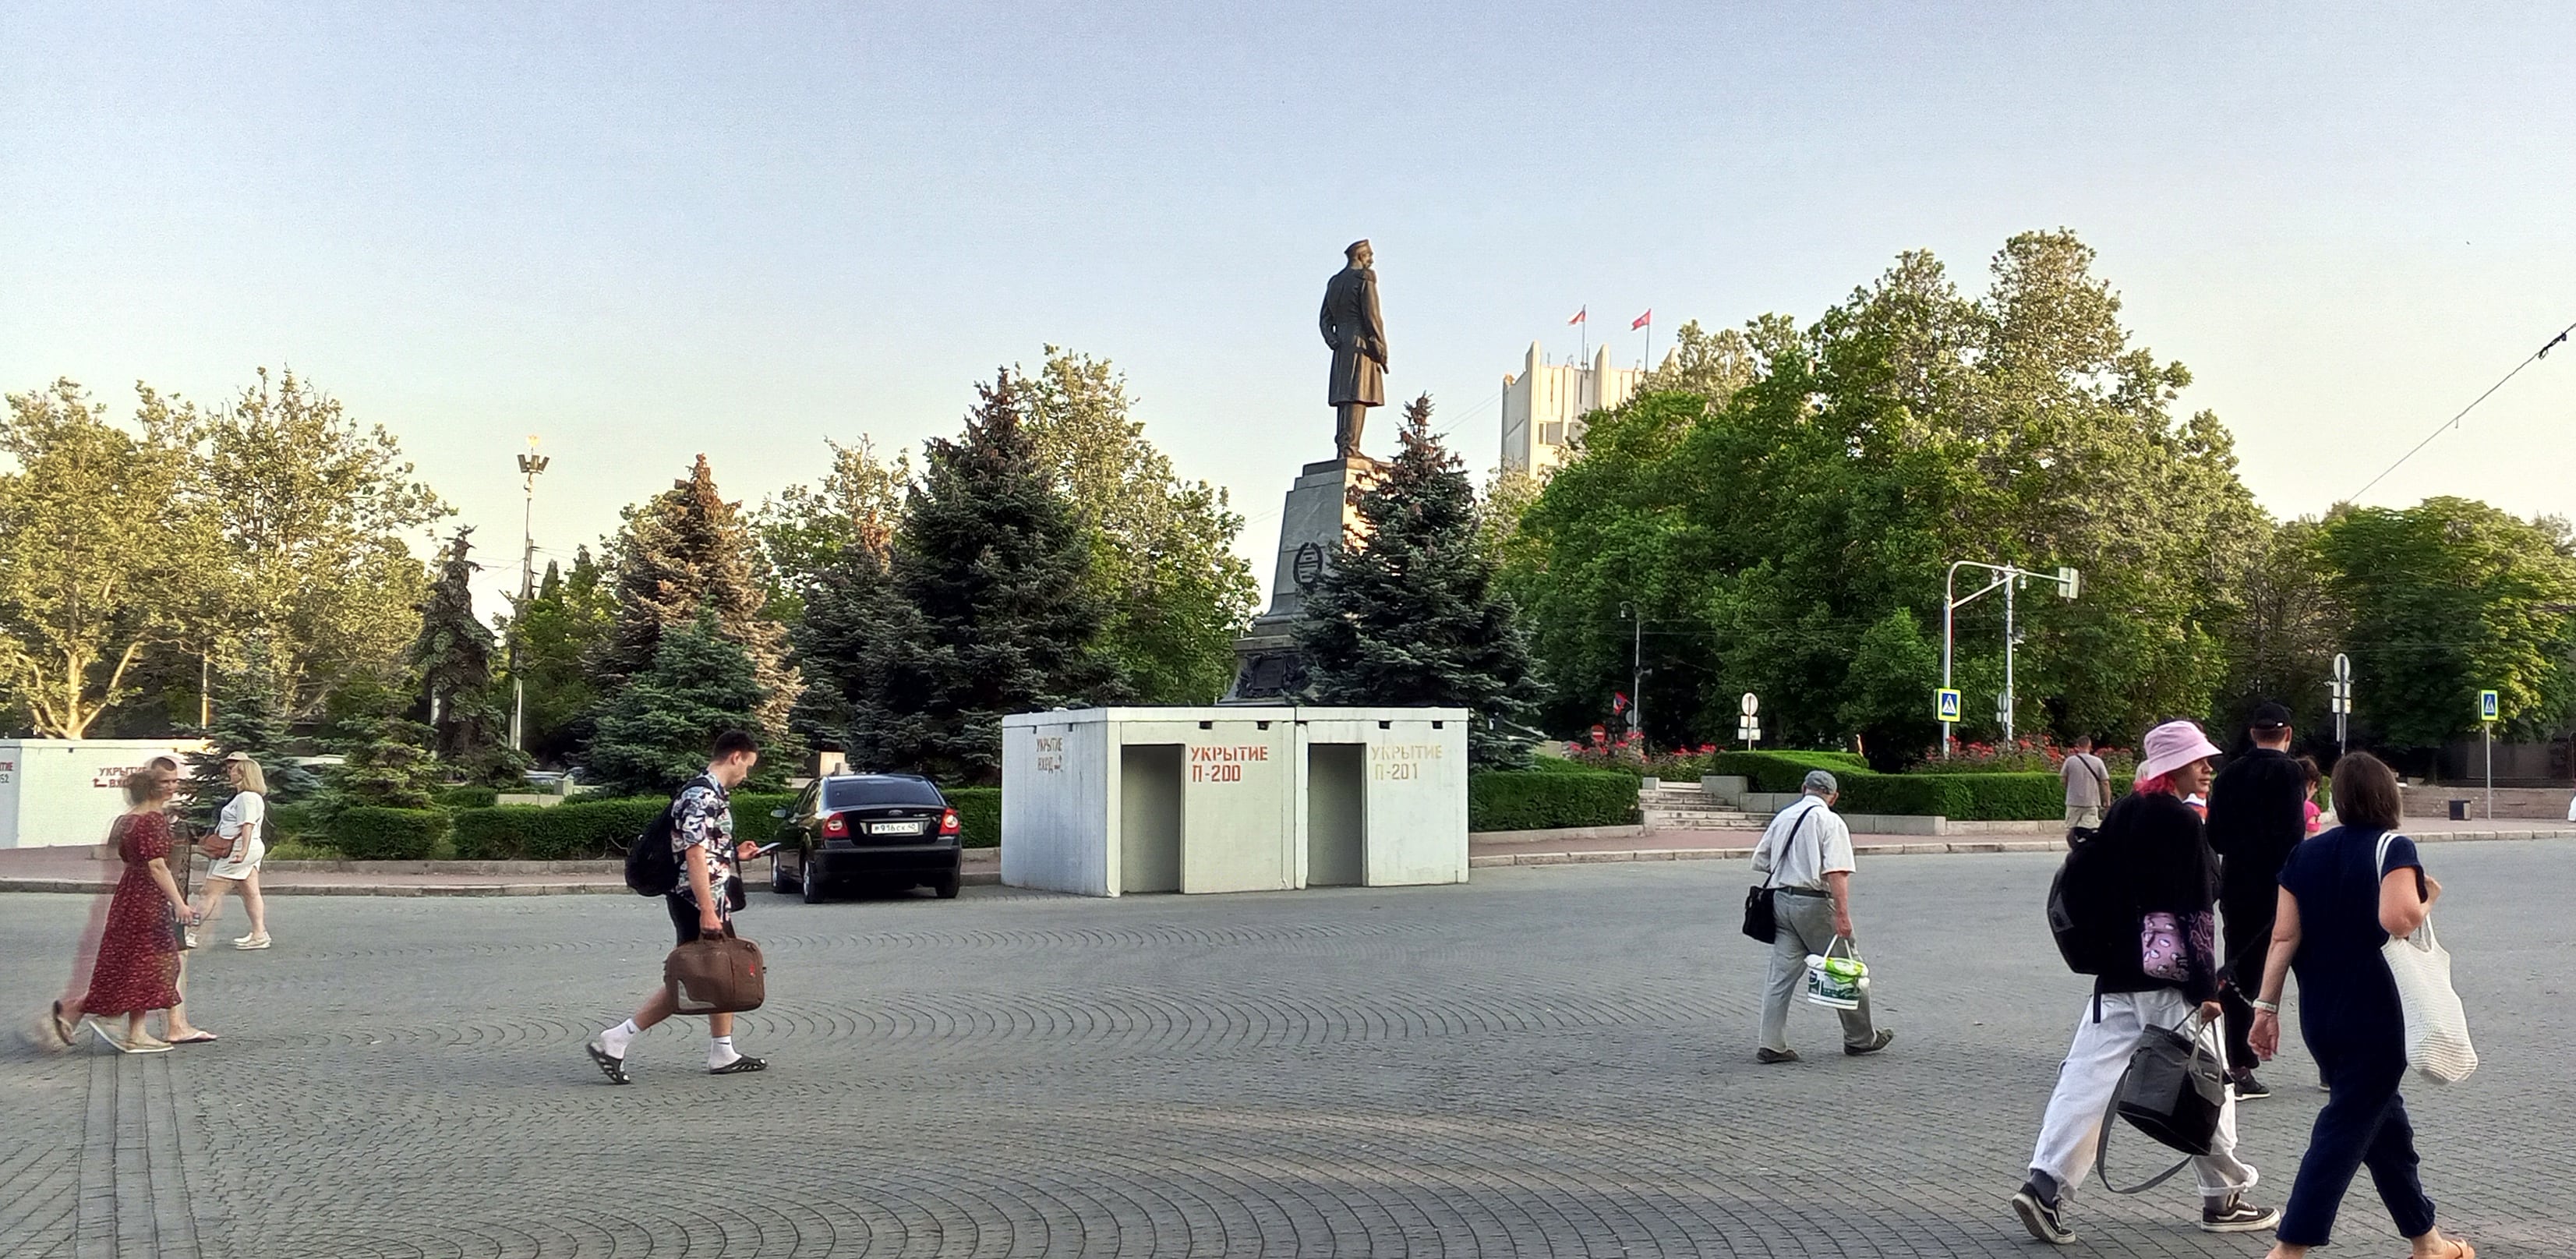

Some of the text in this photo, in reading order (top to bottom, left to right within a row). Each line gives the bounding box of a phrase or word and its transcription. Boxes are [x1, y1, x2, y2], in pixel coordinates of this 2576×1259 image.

[1190, 746, 1268, 762] УКРЫТИЕ
[1370, 745, 1443, 760] УКРЫТИЕ
[1193, 765, 1241, 782] П-200
[1375, 763, 1418, 780] П-201
